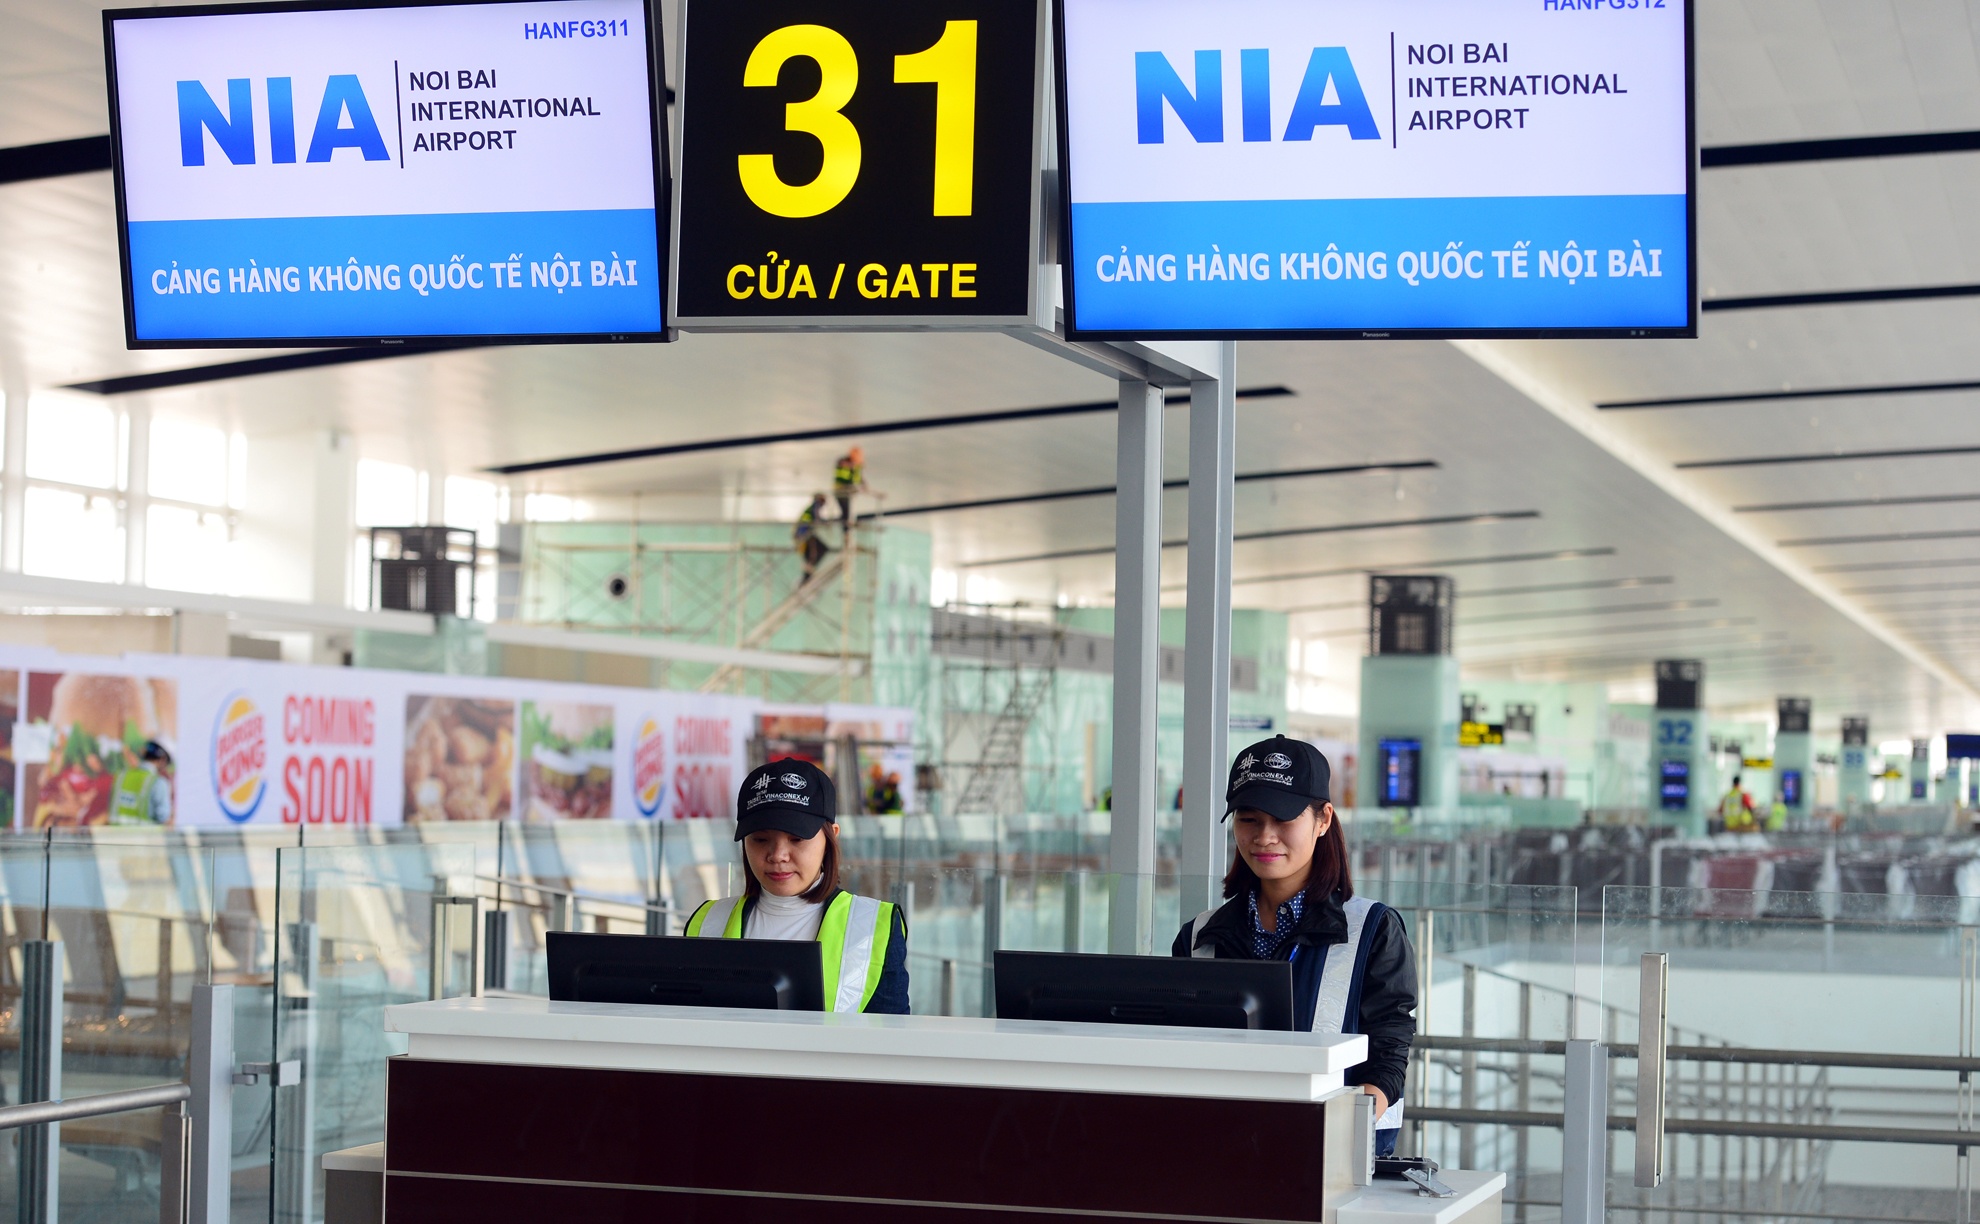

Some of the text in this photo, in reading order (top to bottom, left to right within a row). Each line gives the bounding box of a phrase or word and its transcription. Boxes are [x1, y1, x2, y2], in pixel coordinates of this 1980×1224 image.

[524, 18, 629, 40] HANFG311
[1408, 42, 1509, 65] NOI BAI
[409, 69, 498, 91] NOI BAI
[1135, 46, 1382, 145] NIA
[1408, 73, 1629, 98] INTERNATIONAL
[176, 74, 391, 167] NIA
[411, 96, 602, 122] INTERNATIONAL
[737, 19, 978, 218] 31
[1408, 108, 1530, 131] AIRPORT
[412, 130, 518, 152] AIRPORT
[151, 251, 638, 297] CẢNG HÀNG KHÔNG QUỐC TẾ NỘI BÀI
[726, 250, 818, 300] CỬA
[856, 262, 978, 300] GATE
[1096, 239, 1663, 287] CẢNG HÀNG KHÔNG QUỐC TẾ NỘI BÀI
[283, 694, 375, 746] COMING
[1658, 720, 1693, 746] 32
[217, 738, 265, 796] KING
[282, 755, 374, 824] SOON
[764, 792, 802, 800] VINACONEX
